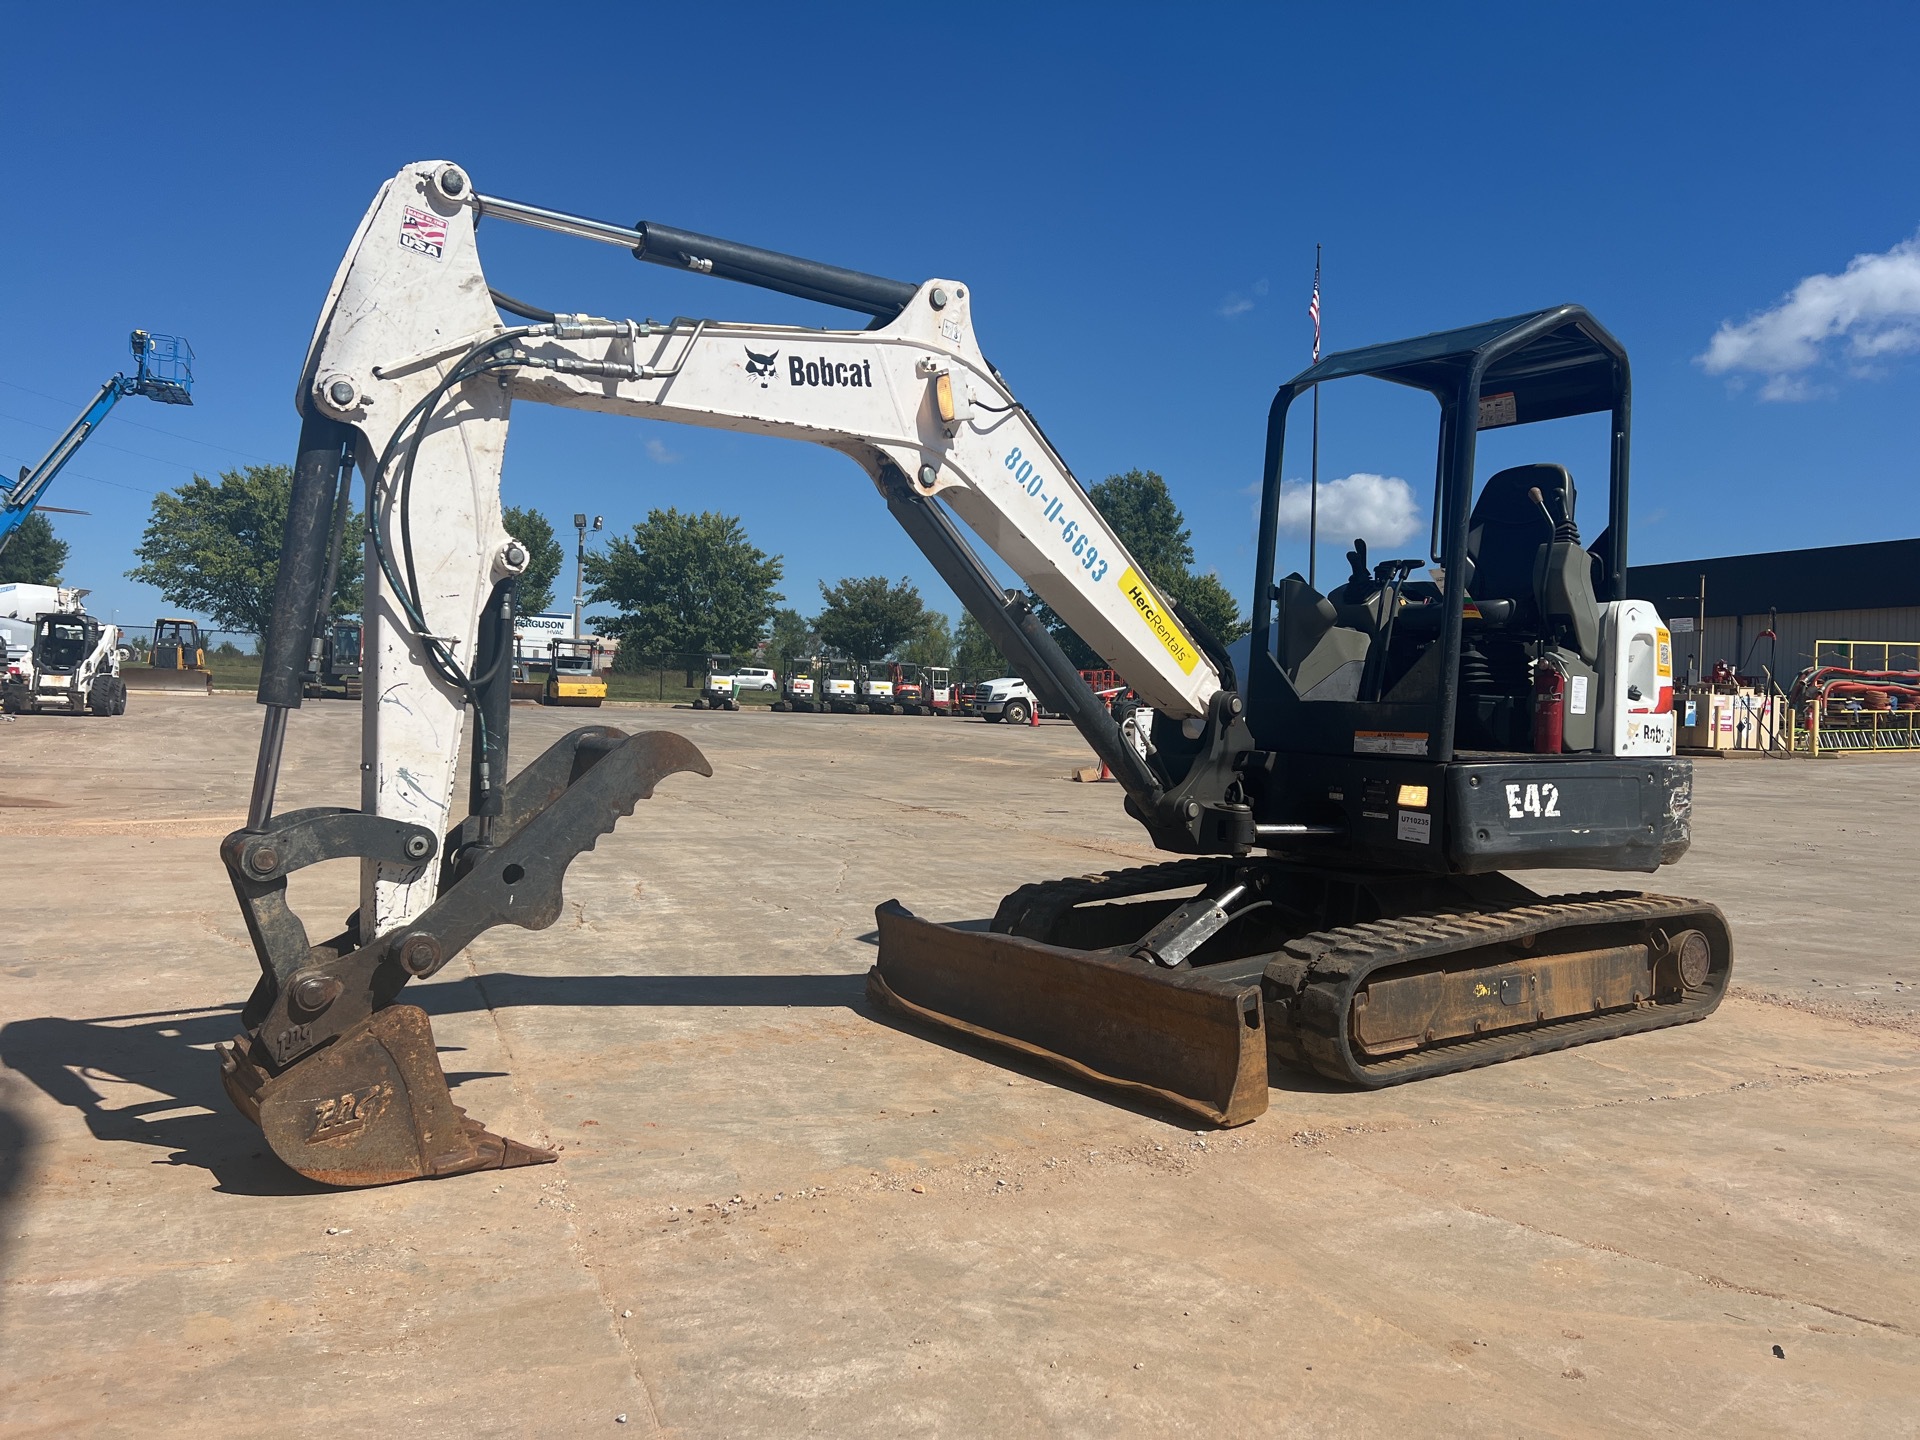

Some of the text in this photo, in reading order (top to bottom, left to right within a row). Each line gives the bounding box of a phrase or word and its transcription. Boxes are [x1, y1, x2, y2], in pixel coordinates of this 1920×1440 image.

[402, 234, 440, 258] USA
[788, 356, 872, 387] Bobcat
[515, 620, 564, 629] FERGUSON
[1505, 783, 1561, 818] E42
[1401, 816, 1429, 826] U710235
